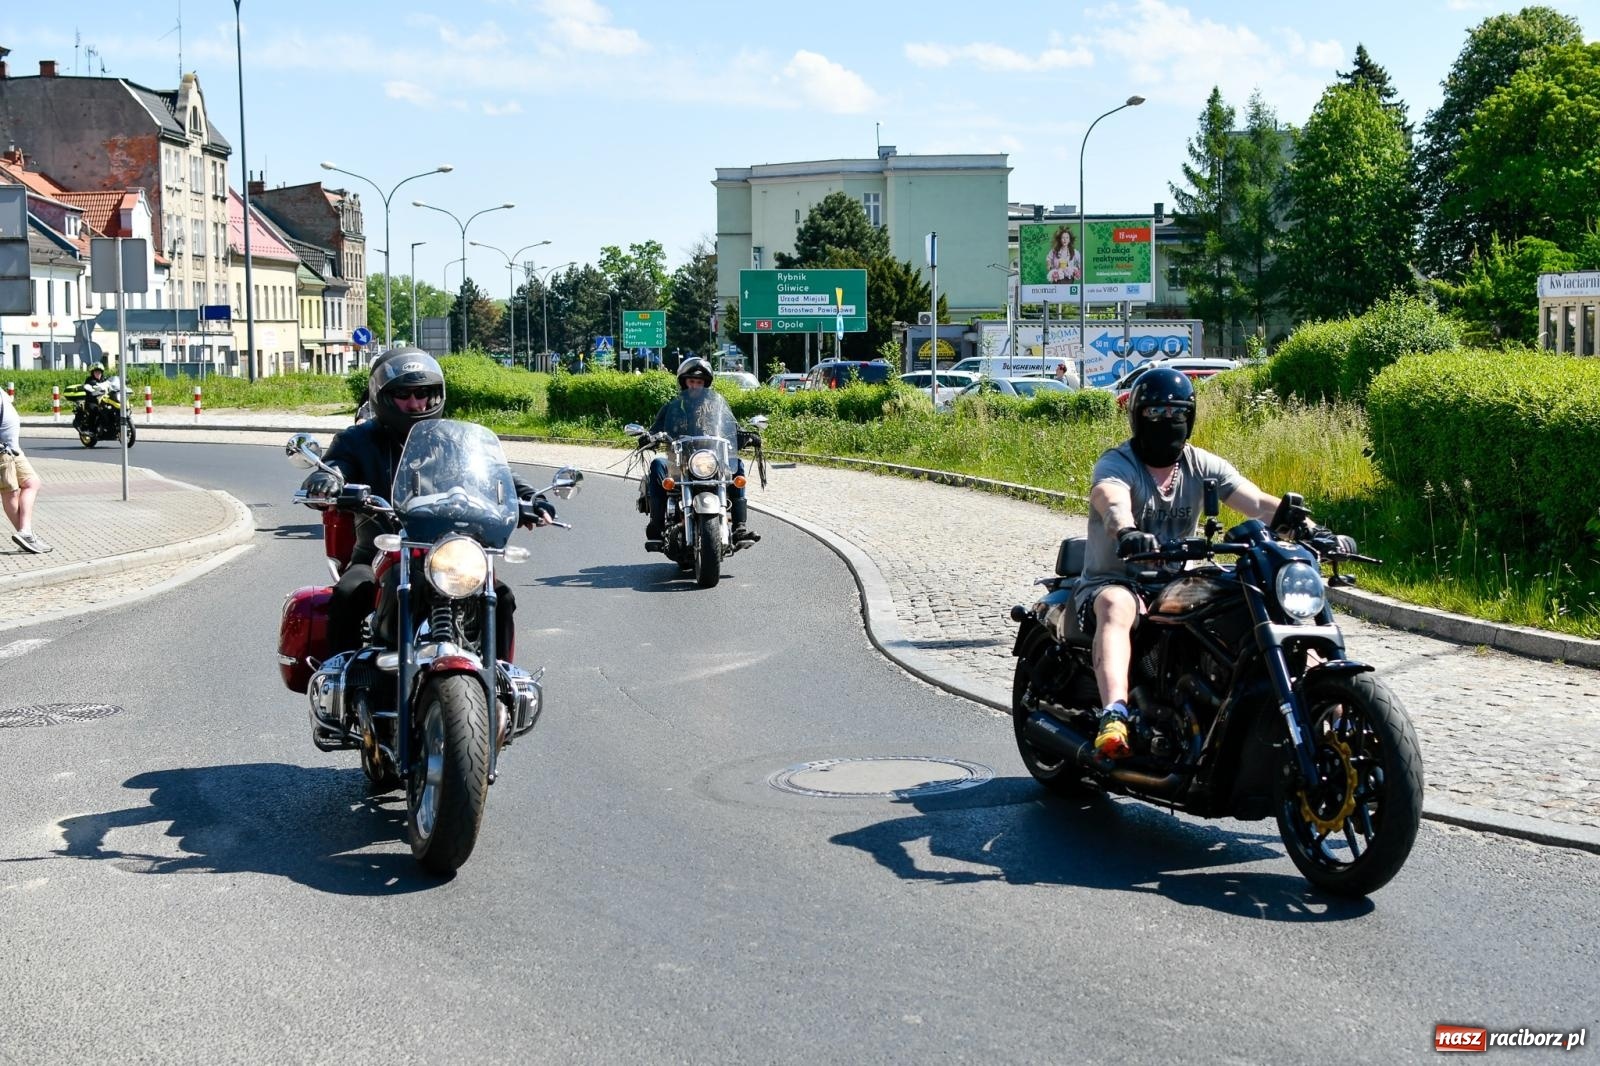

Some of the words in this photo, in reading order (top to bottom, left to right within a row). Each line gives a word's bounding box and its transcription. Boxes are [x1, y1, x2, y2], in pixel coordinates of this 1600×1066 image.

[1112, 246, 1130, 256] akcja
[778, 273, 806, 282] Rybnik
[776, 284, 810, 292] Gliwice
[1002, 362, 1052, 370] JUNGHEINRIH
